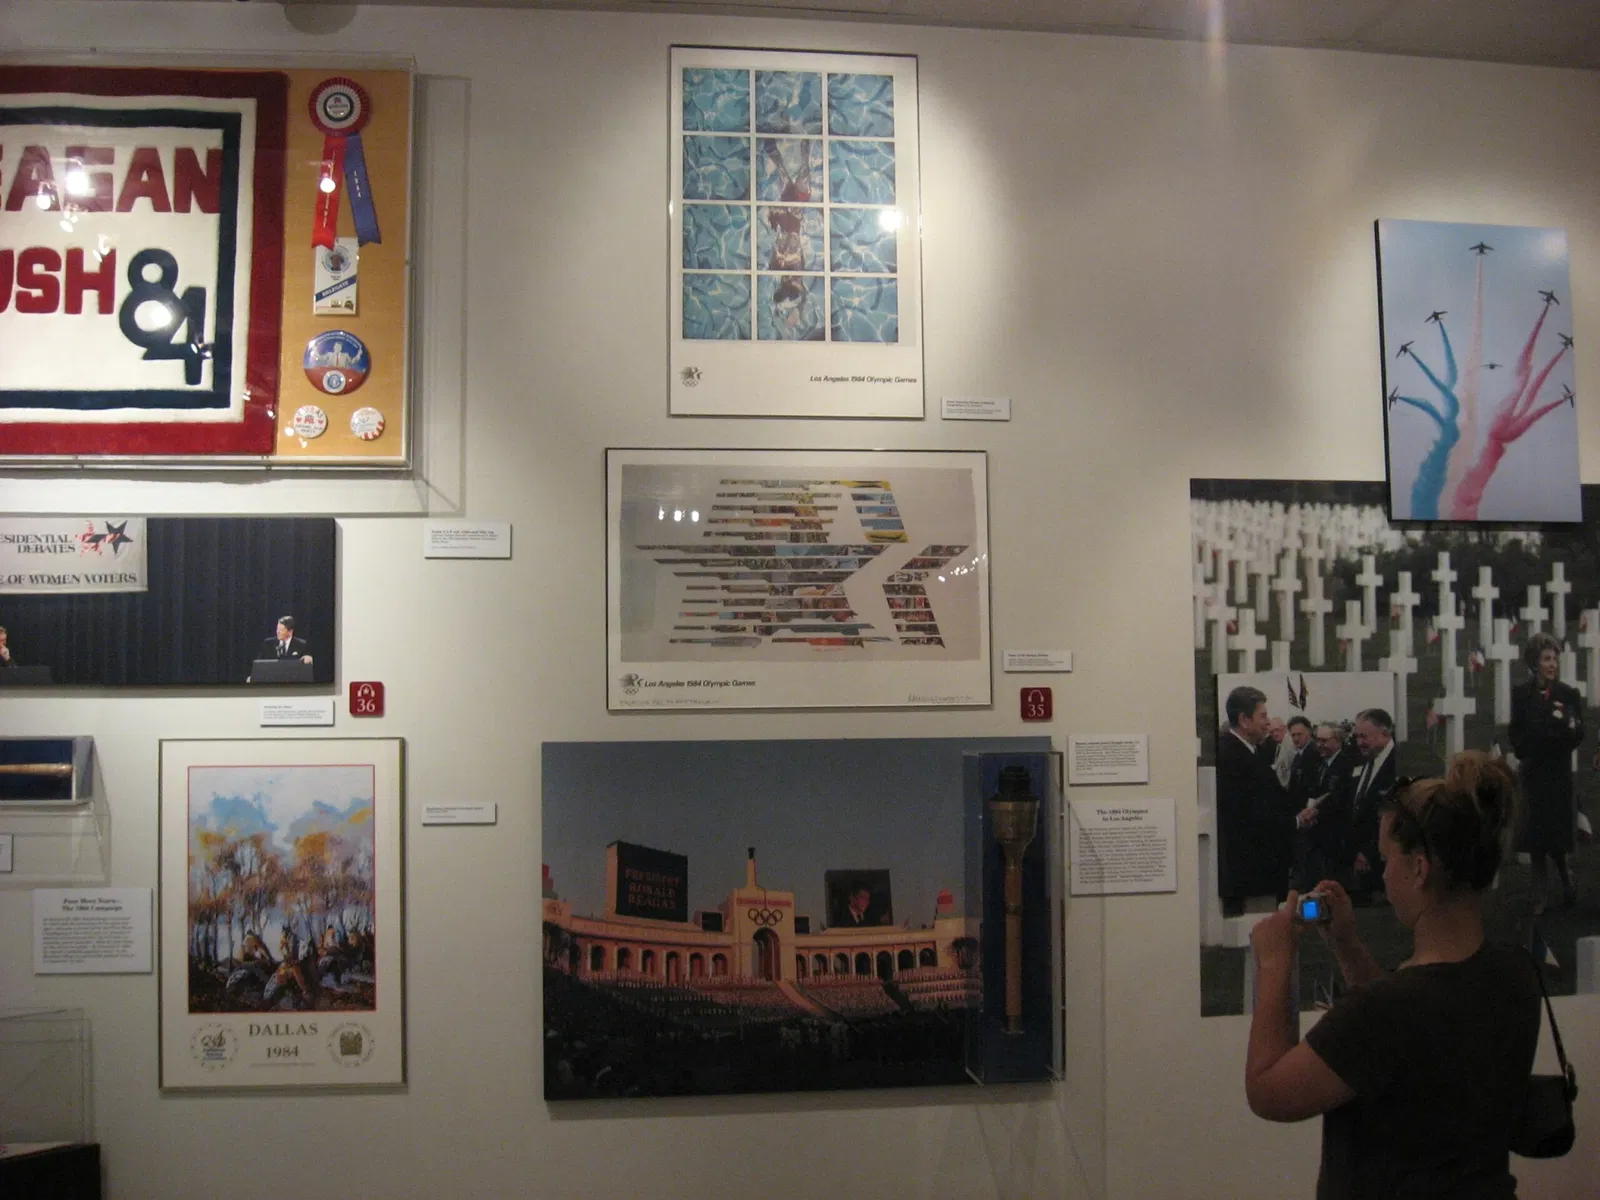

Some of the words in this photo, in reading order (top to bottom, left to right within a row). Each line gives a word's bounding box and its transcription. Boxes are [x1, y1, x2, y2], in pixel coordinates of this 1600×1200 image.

[0, 144, 222, 214] AGAN
[118, 248, 214, 386] 84
[823, 375, 849, 384] Angeles
[866, 376, 893, 384] Olympic
[17, 543, 76, 554] DEBATES
[7, 574, 26, 585] OF
[28, 574, 80, 585] WOMEN
[82, 572, 138, 585] VOTERS
[658, 680, 685, 688] Angeles
[703, 680, 730, 688] Olympic
[356, 698, 376, 713] 36
[1027, 703, 1045, 717] 35
[248, 1022, 318, 1037] DALLAS
[265, 1045, 300, 1058] 1984
